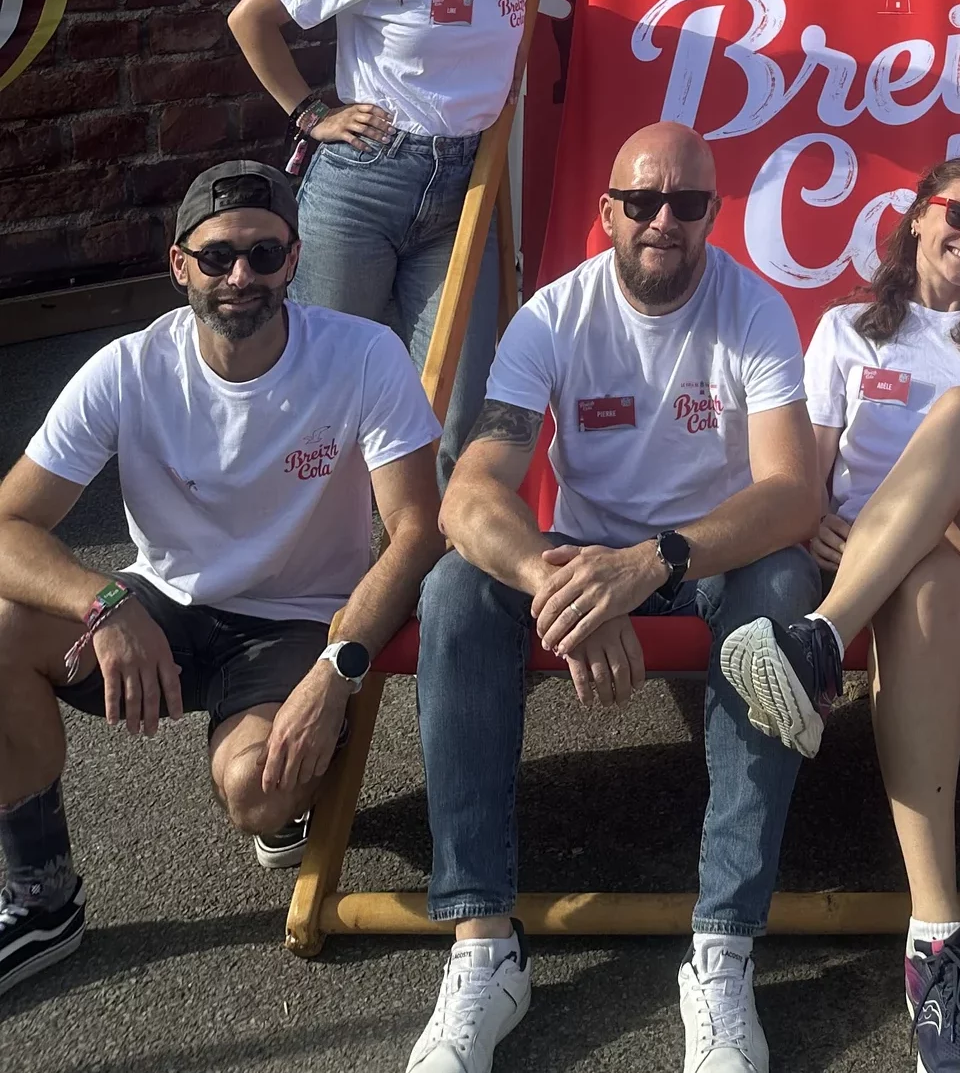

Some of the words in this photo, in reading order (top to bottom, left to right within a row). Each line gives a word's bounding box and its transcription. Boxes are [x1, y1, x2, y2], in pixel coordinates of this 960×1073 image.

[687, 413, 719, 433] Cola
[283, 438, 339, 473] Breizh
[298, 459, 333, 480] Cola
